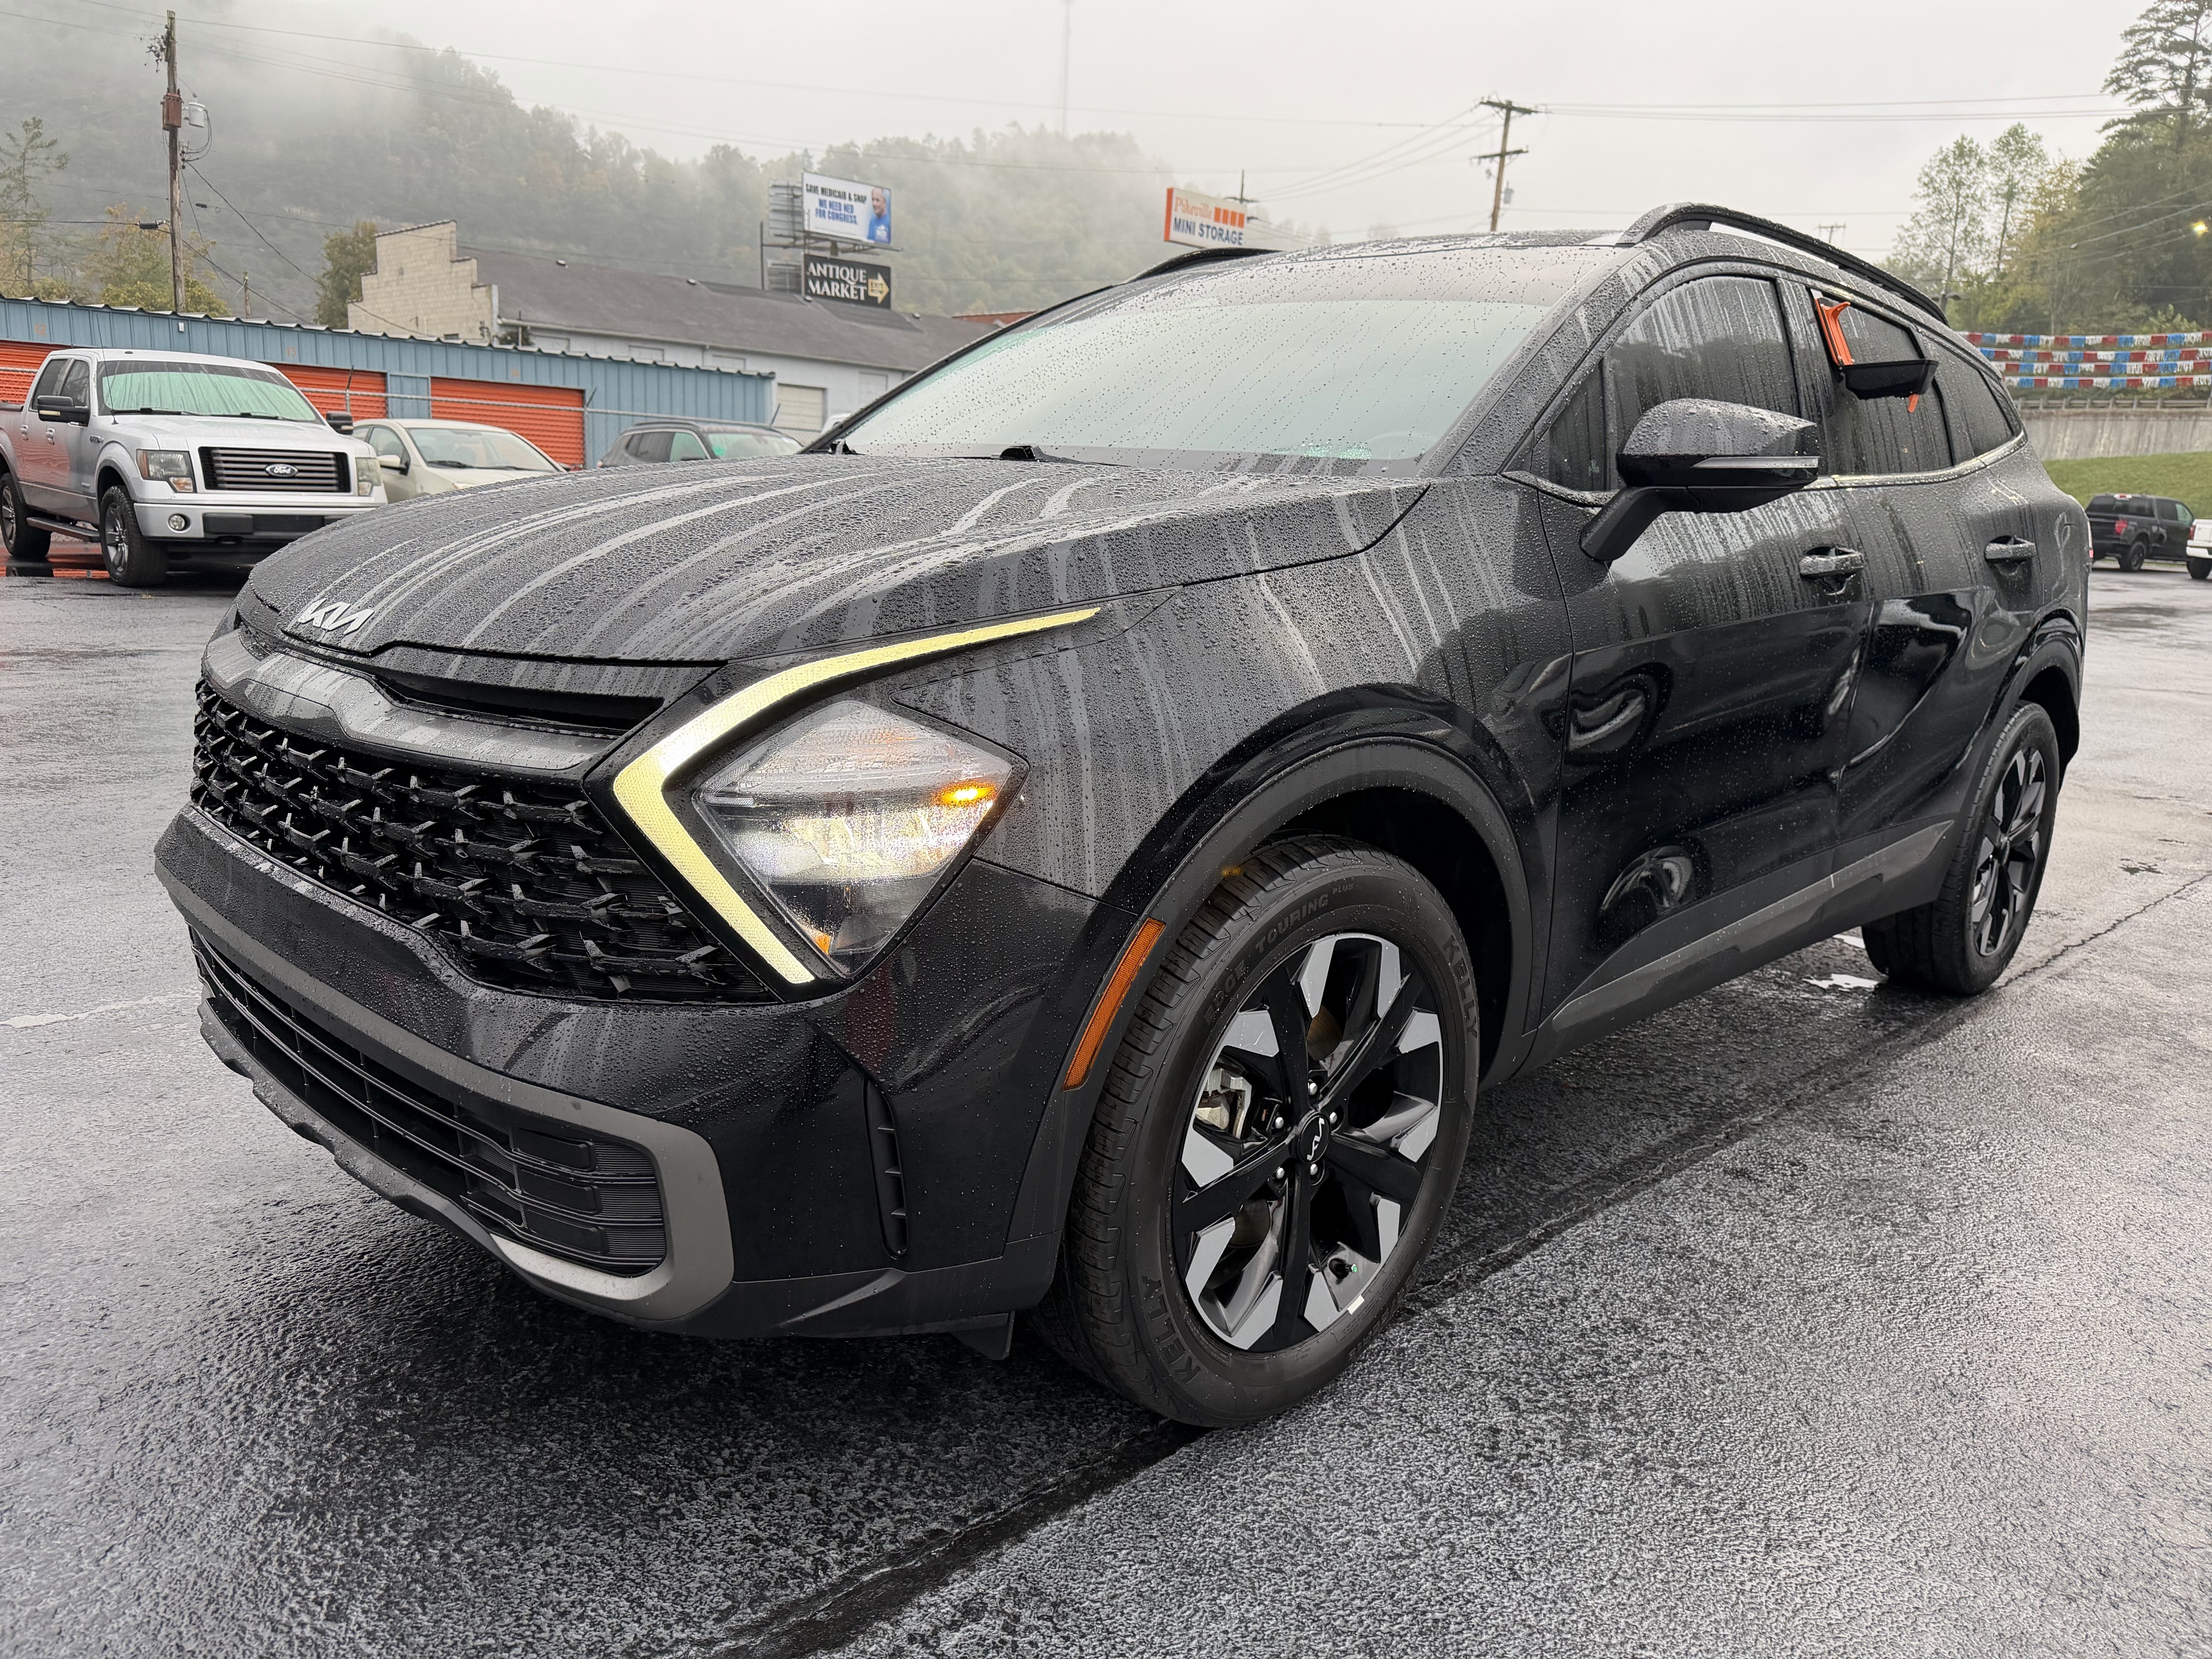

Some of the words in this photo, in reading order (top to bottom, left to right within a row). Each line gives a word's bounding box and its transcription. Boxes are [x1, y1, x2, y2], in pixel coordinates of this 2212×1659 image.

[815, 208, 826, 219] FOR
[829, 200, 842, 211] NEED
[1173, 216, 1196, 235] MINI
[1198, 223, 1243, 246] STORAGE
[807, 261, 867, 285] ANTIQUE
[808, 278, 867, 301] MARKET
[35, 323, 47, 335] 12
[287, 347, 296, 357] 13
[274, 465, 291, 474] Ford
[1204, 959, 1249, 1025] EDGE
[1255, 893, 1329, 953] TOURING
[1332, 883, 1354, 895] PLUS
[1443, 934, 1478, 1039] KELLY
[1141, 1275, 1201, 1385] KELLY
